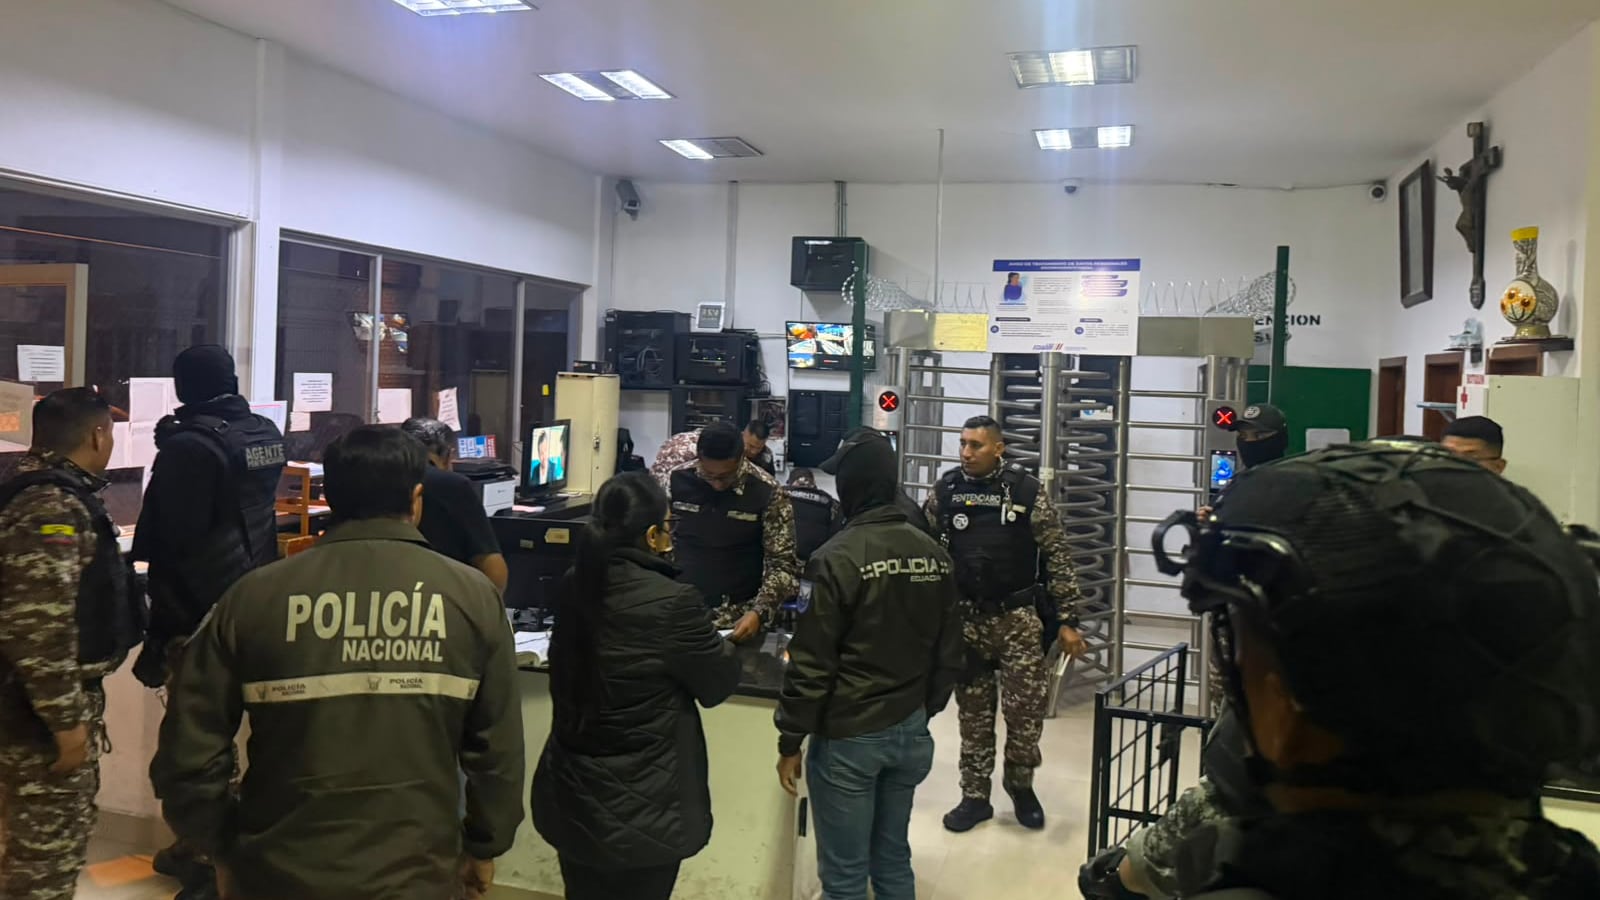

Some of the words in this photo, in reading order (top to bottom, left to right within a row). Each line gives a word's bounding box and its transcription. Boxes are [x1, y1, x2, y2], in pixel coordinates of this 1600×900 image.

[245, 443, 284, 460] AGENTE
[286, 581, 447, 643] POLICÍA
[342, 638, 443, 662] NACIONAL
